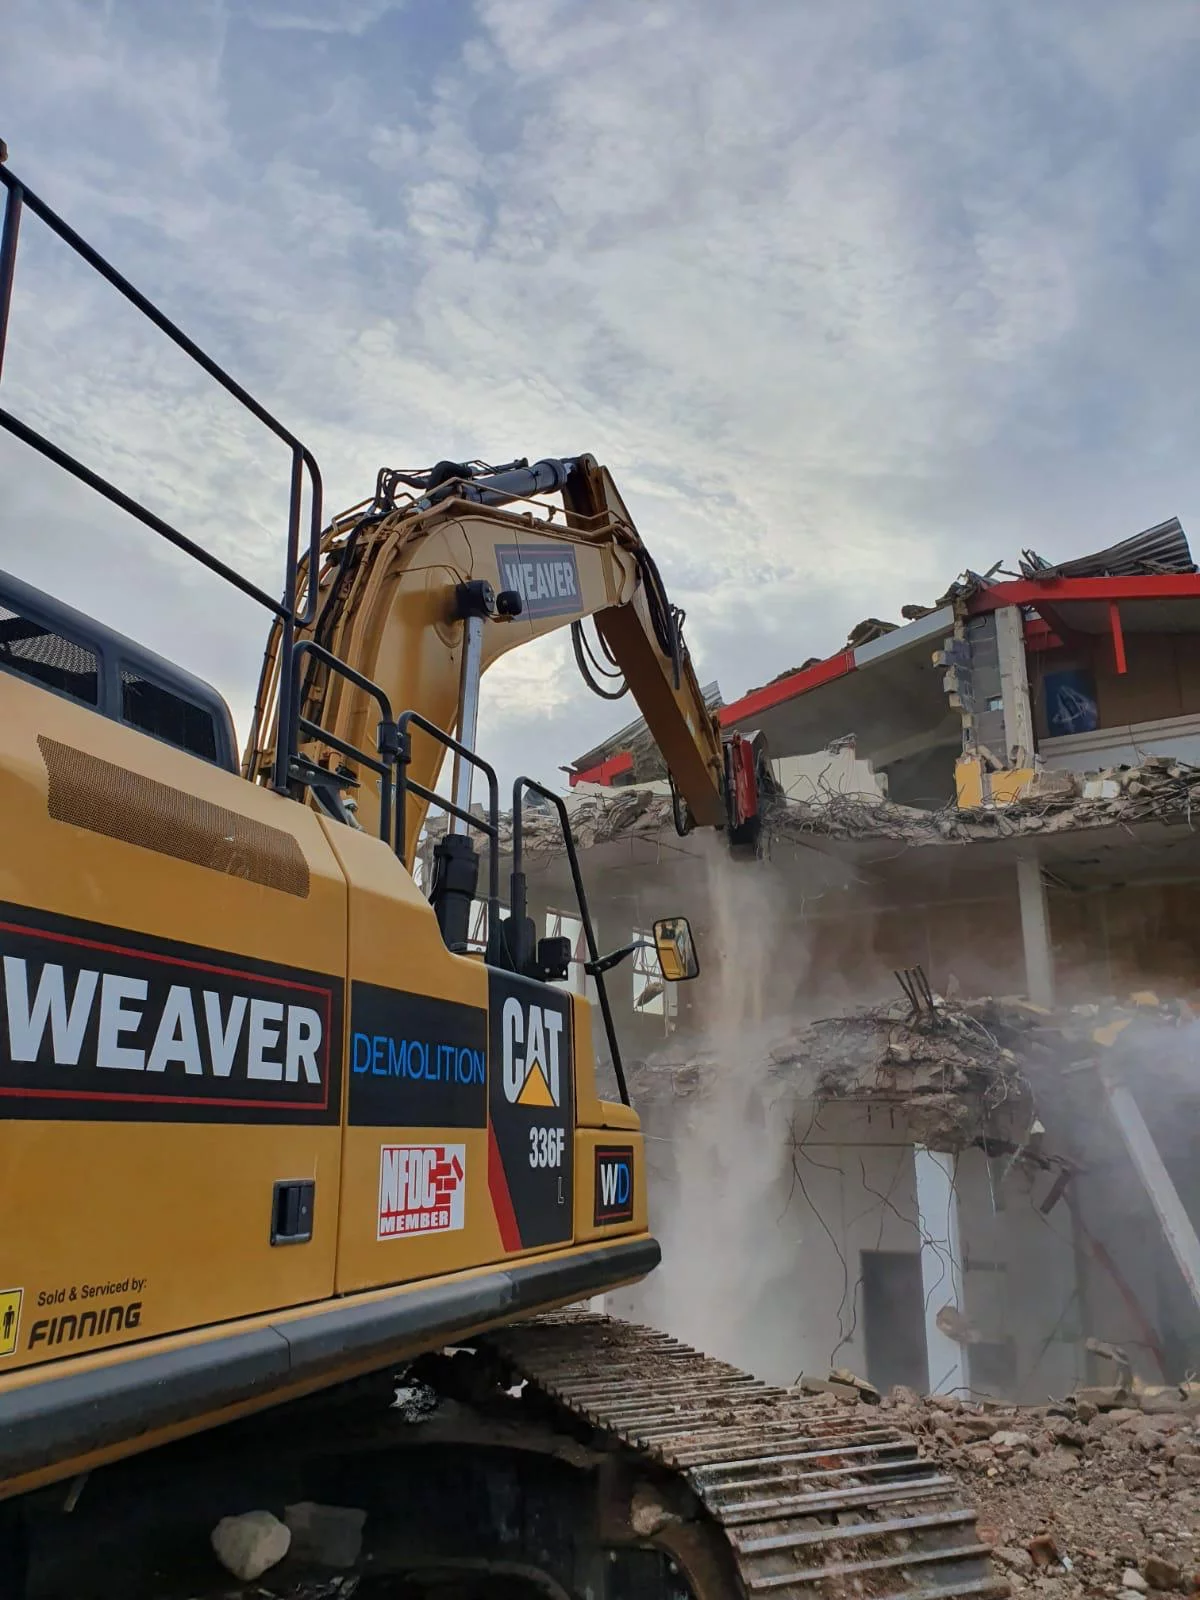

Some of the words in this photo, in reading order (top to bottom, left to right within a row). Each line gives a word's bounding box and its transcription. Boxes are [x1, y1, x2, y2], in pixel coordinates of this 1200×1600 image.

[504, 562, 577, 601] WEAVER
[3, 955, 323, 1085] WEAVER
[353, 1032, 486, 1085] DEMOLITION
[502, 996, 563, 1108] CAT
[529, 1126, 565, 1169] 336F
[381, 1149, 438, 1214] NFDC
[600, 1163, 630, 1207] WD
[380, 1210, 450, 1234] MEMBER
[37, 1288, 66, 1307] Sold
[69, 1286, 77, 1302] &
[81, 1278, 129, 1300] Serviced
[131, 1277, 148, 1293] by:
[27, 1301, 143, 1351] FINNING
